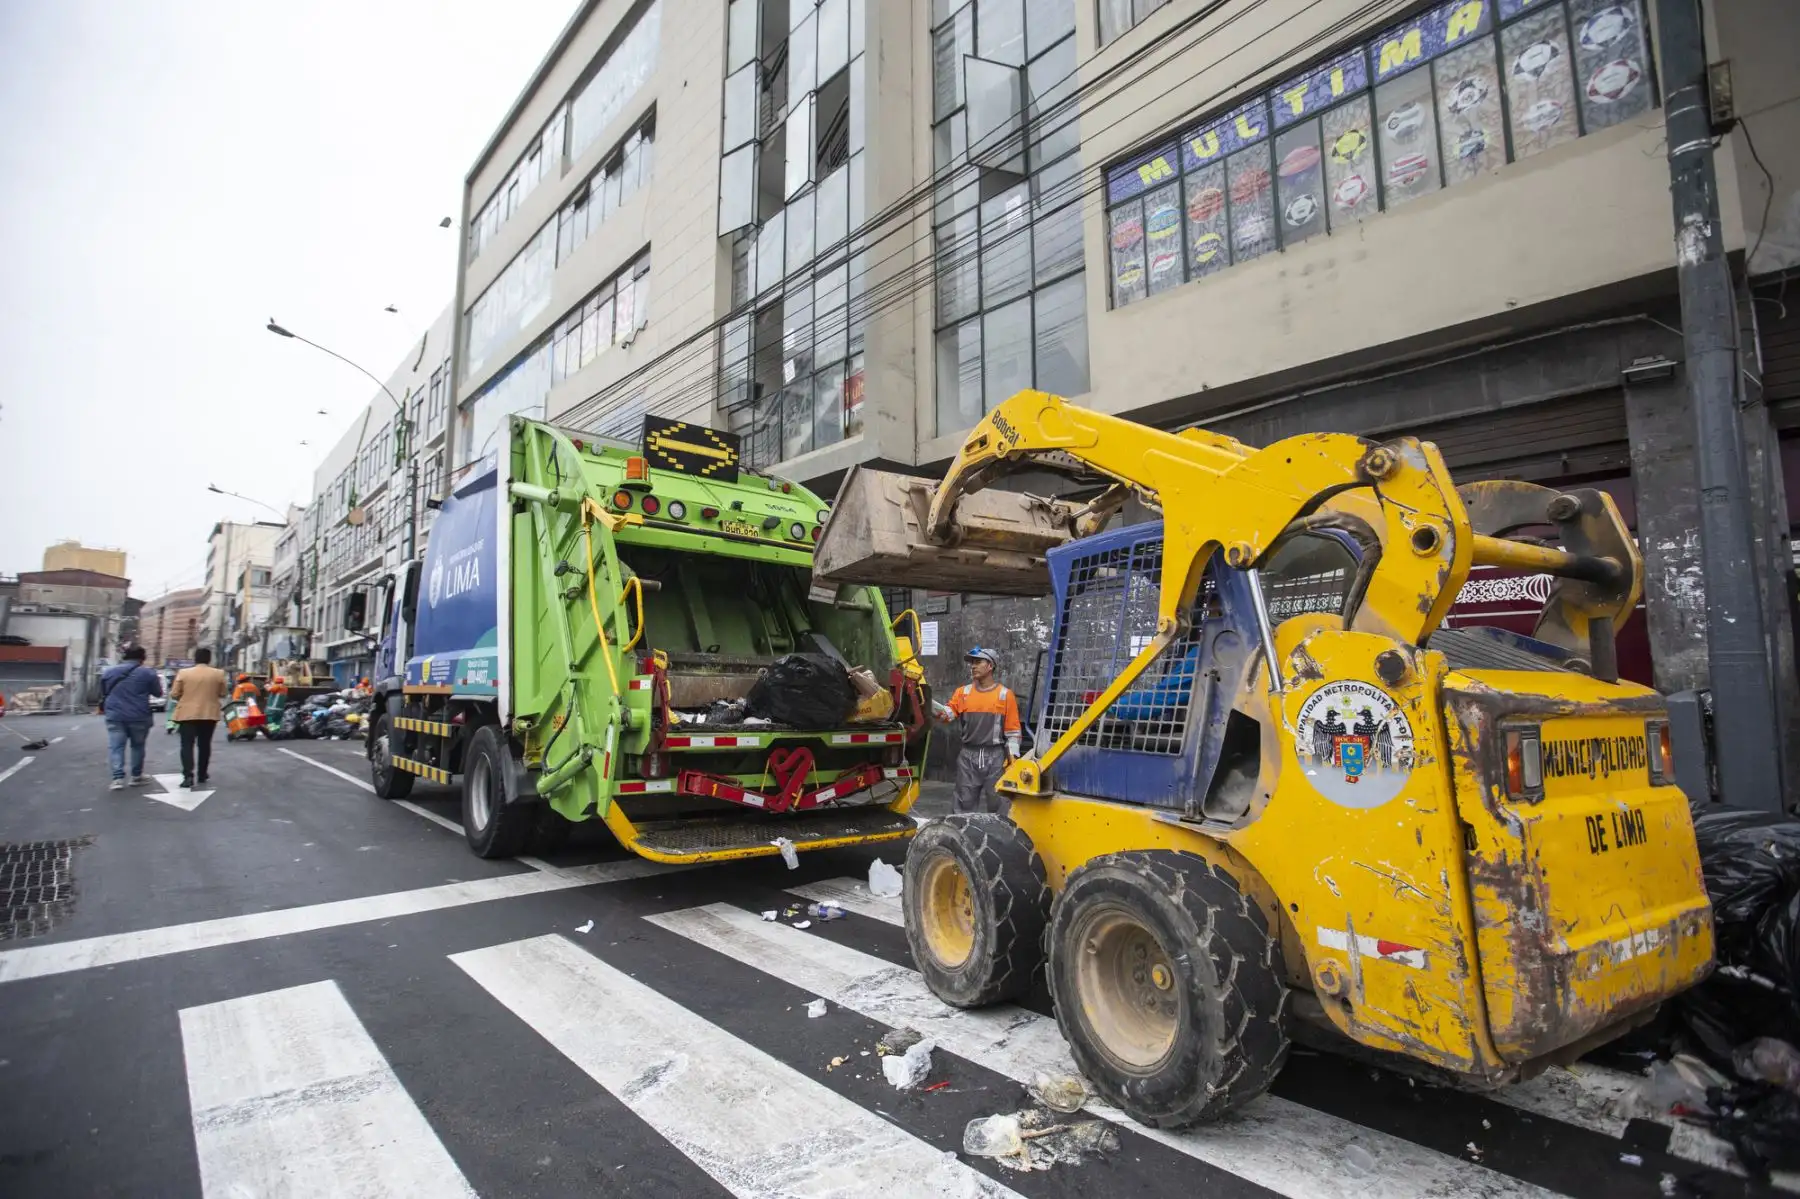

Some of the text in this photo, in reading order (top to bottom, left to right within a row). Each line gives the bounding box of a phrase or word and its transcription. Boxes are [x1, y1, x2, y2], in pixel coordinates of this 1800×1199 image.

[1138, 0, 1530, 185] MULTIMA
[992, 409, 1020, 448] Bobcat
[446, 556, 480, 599] LIMA
[1324, 685, 1402, 724] METROPOLITAA
[1542, 736, 1646, 778] MUNICIPALIDAD
[712, 783, 718, 796] 1
[857, 775, 865, 788] 2
[1586, 808, 1647, 854] DE LIMA
